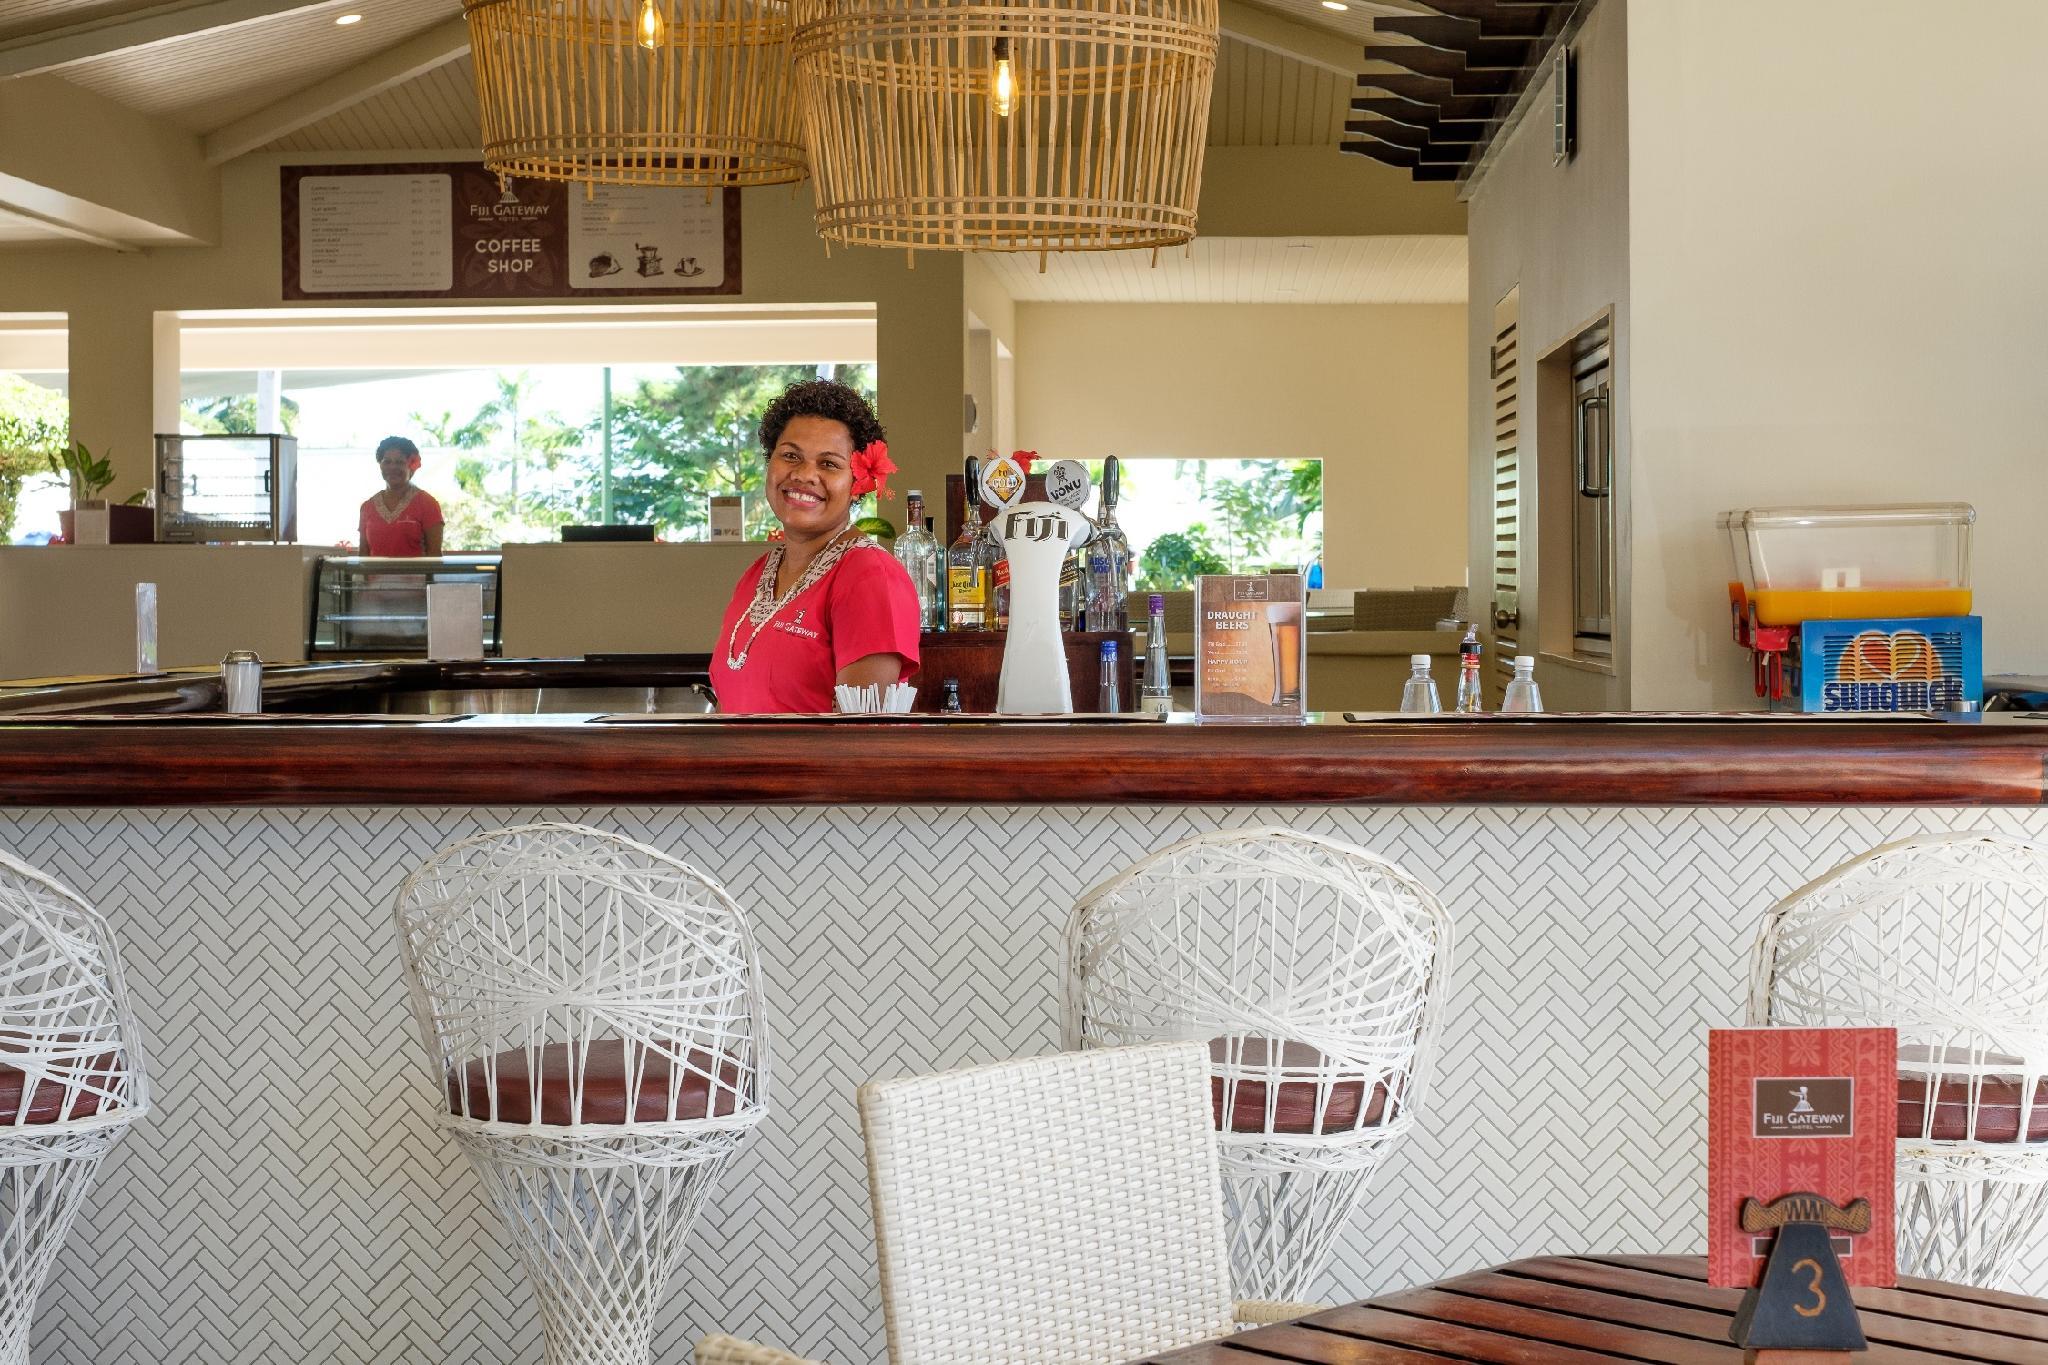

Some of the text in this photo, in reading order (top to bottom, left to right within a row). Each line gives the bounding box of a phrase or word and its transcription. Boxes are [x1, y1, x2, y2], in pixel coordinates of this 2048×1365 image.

[493, 204, 550, 216] GATEWAY
[475, 238, 541, 254] COFFEE
[487, 258, 534, 273] SHOP
[1050, 478, 1082, 501] VONU
[1207, 611, 1258, 620] DRAUGHT
[1215, 621, 1249, 630] BEERS
[1787, 1112, 1845, 1125] GATEWAY
[1791, 1258, 1827, 1318] 3
